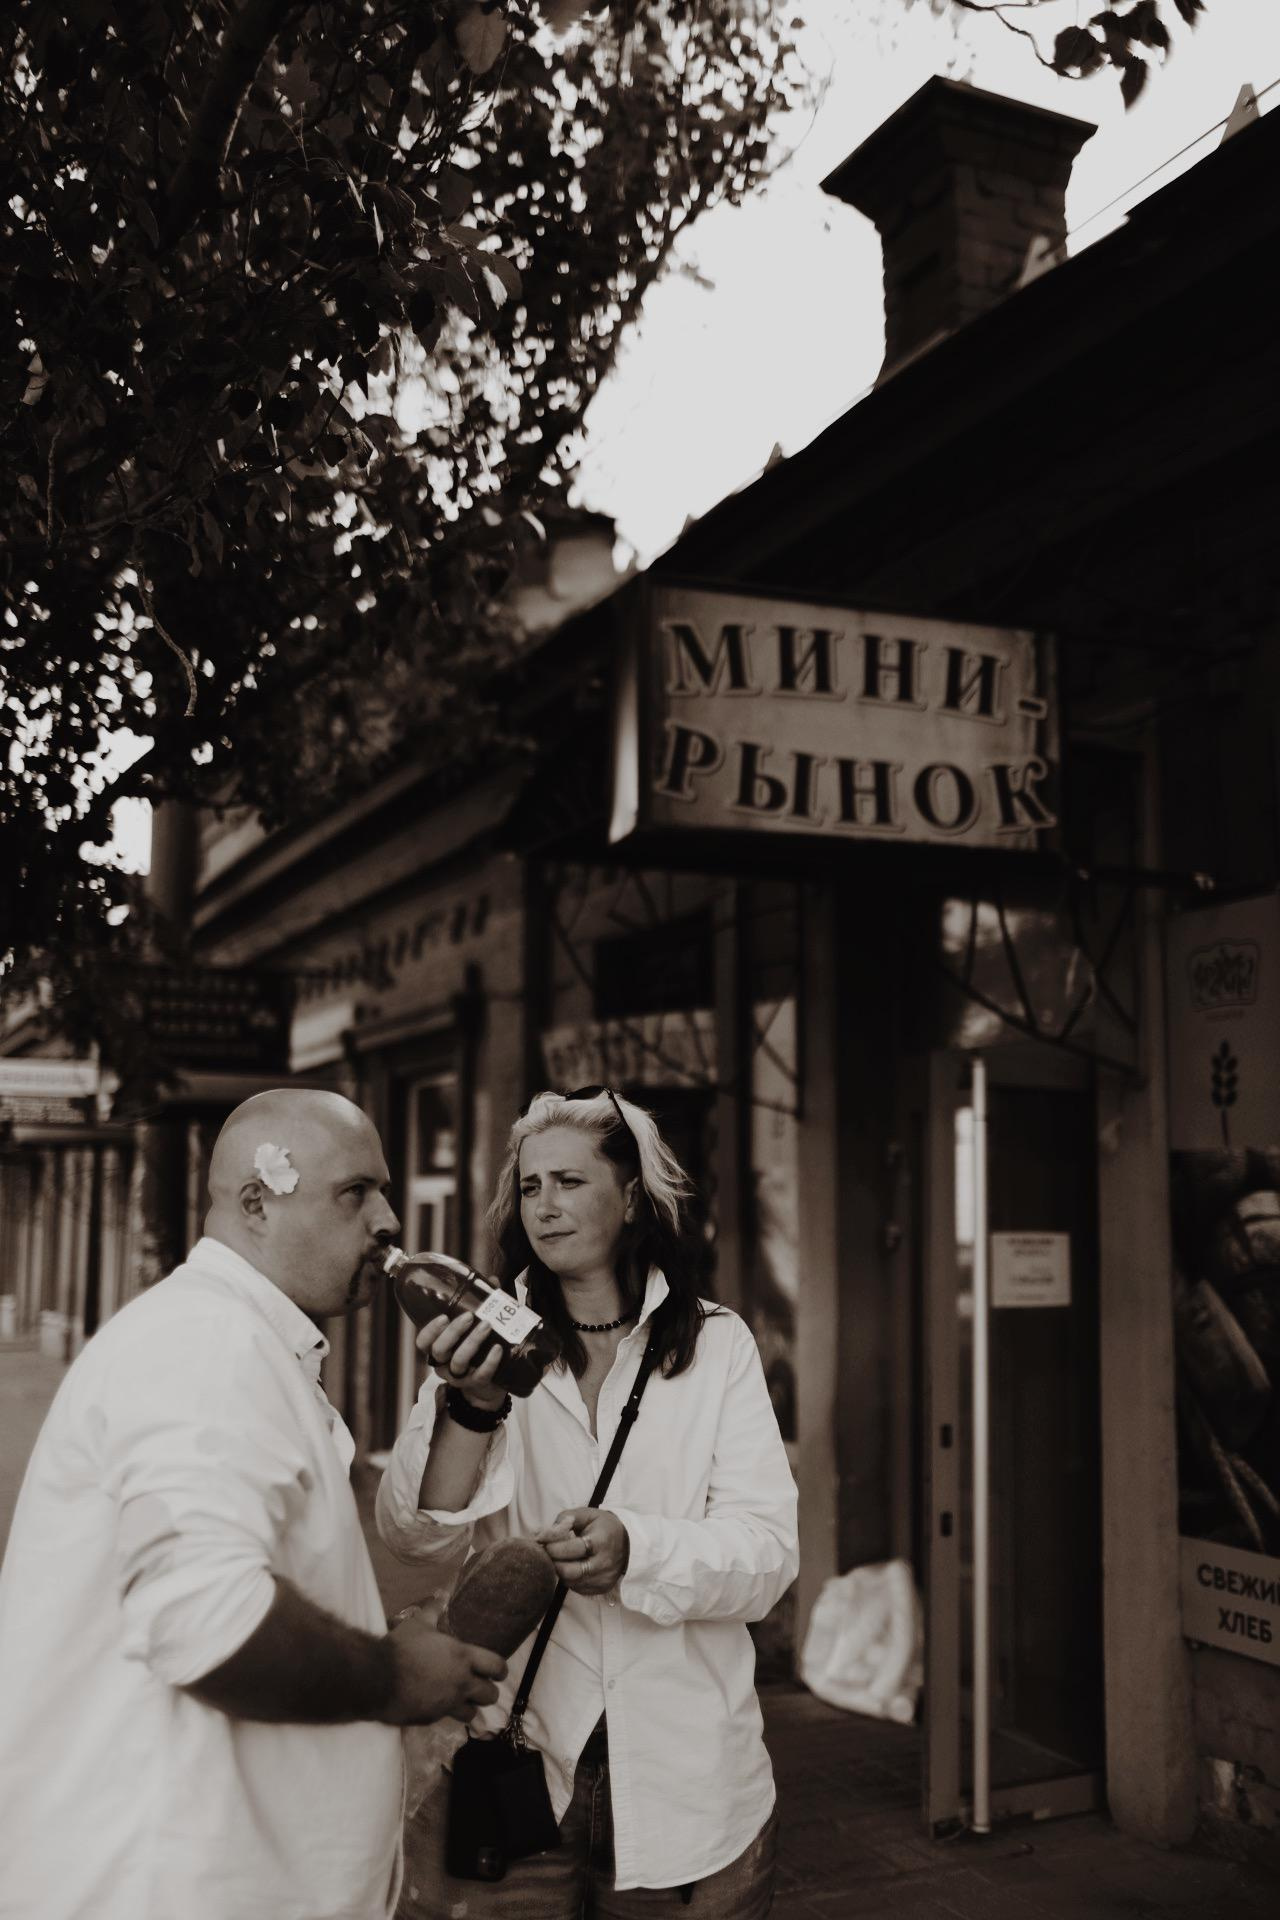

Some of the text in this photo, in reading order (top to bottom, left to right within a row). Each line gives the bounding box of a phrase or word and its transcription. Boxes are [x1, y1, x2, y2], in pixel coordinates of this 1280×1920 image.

[660, 621, 1047, 725] МИНИ-
[655, 720, 1057, 834] РЫНОК
[1197, 1563, 1280, 1606] СВЕЖИ
[1218, 1606, 1273, 1643] ХЛЕБ
